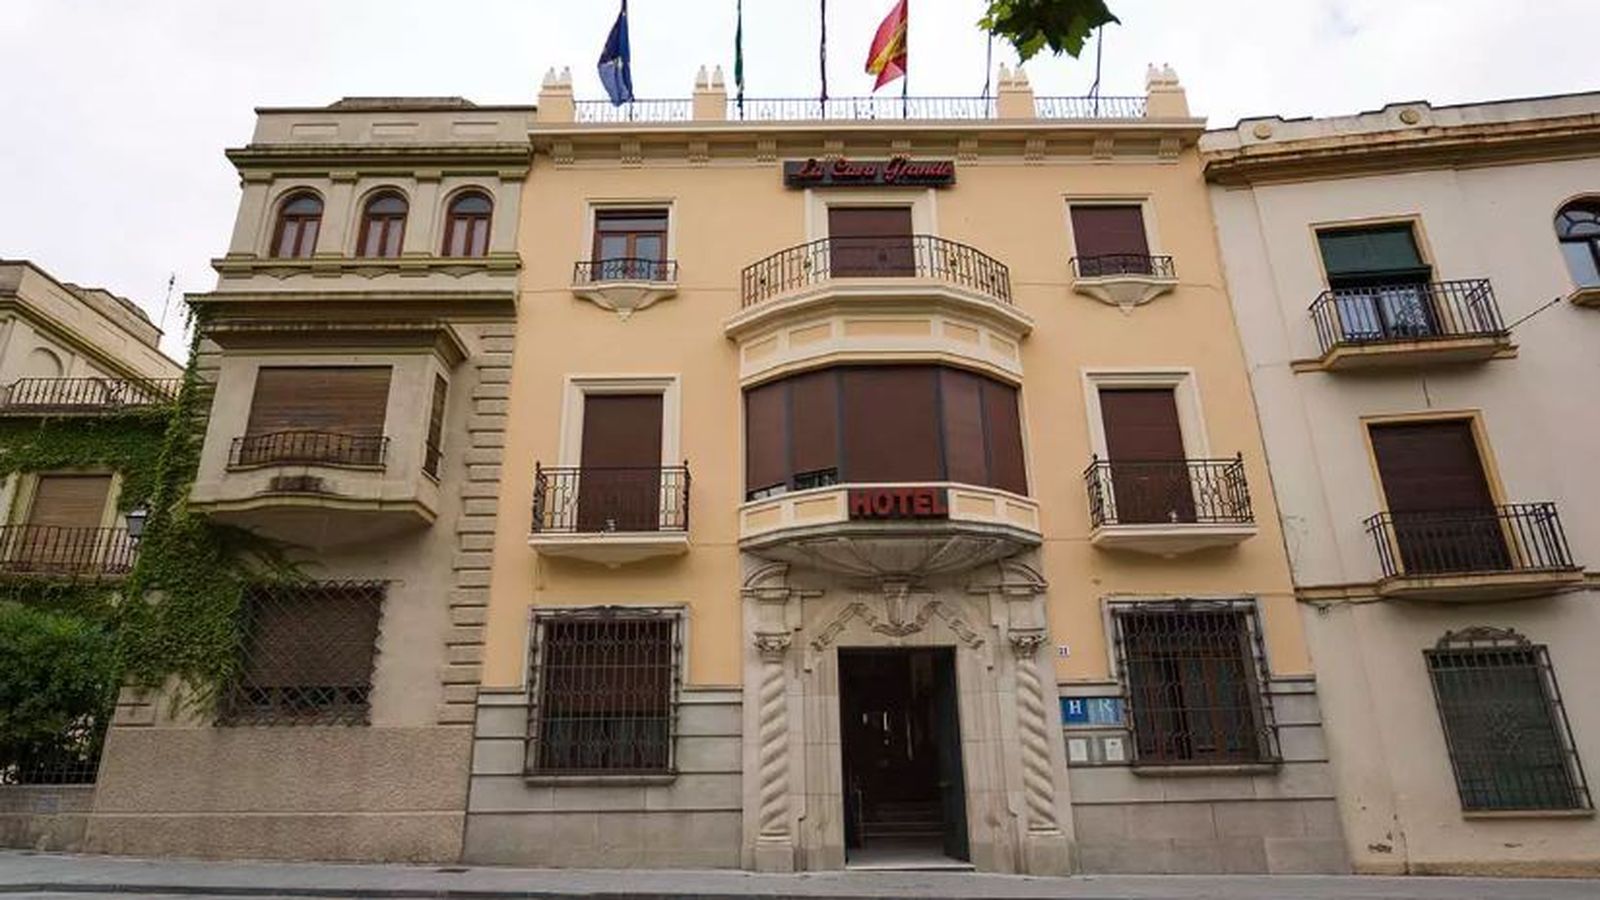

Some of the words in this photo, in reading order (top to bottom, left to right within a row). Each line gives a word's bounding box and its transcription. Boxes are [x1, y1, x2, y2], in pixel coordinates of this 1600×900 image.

[796, 158, 822, 178] La
[831, 158, 876, 179] Casa
[850, 488, 949, 516] HOTEL
[1069, 700, 1082, 715] H
